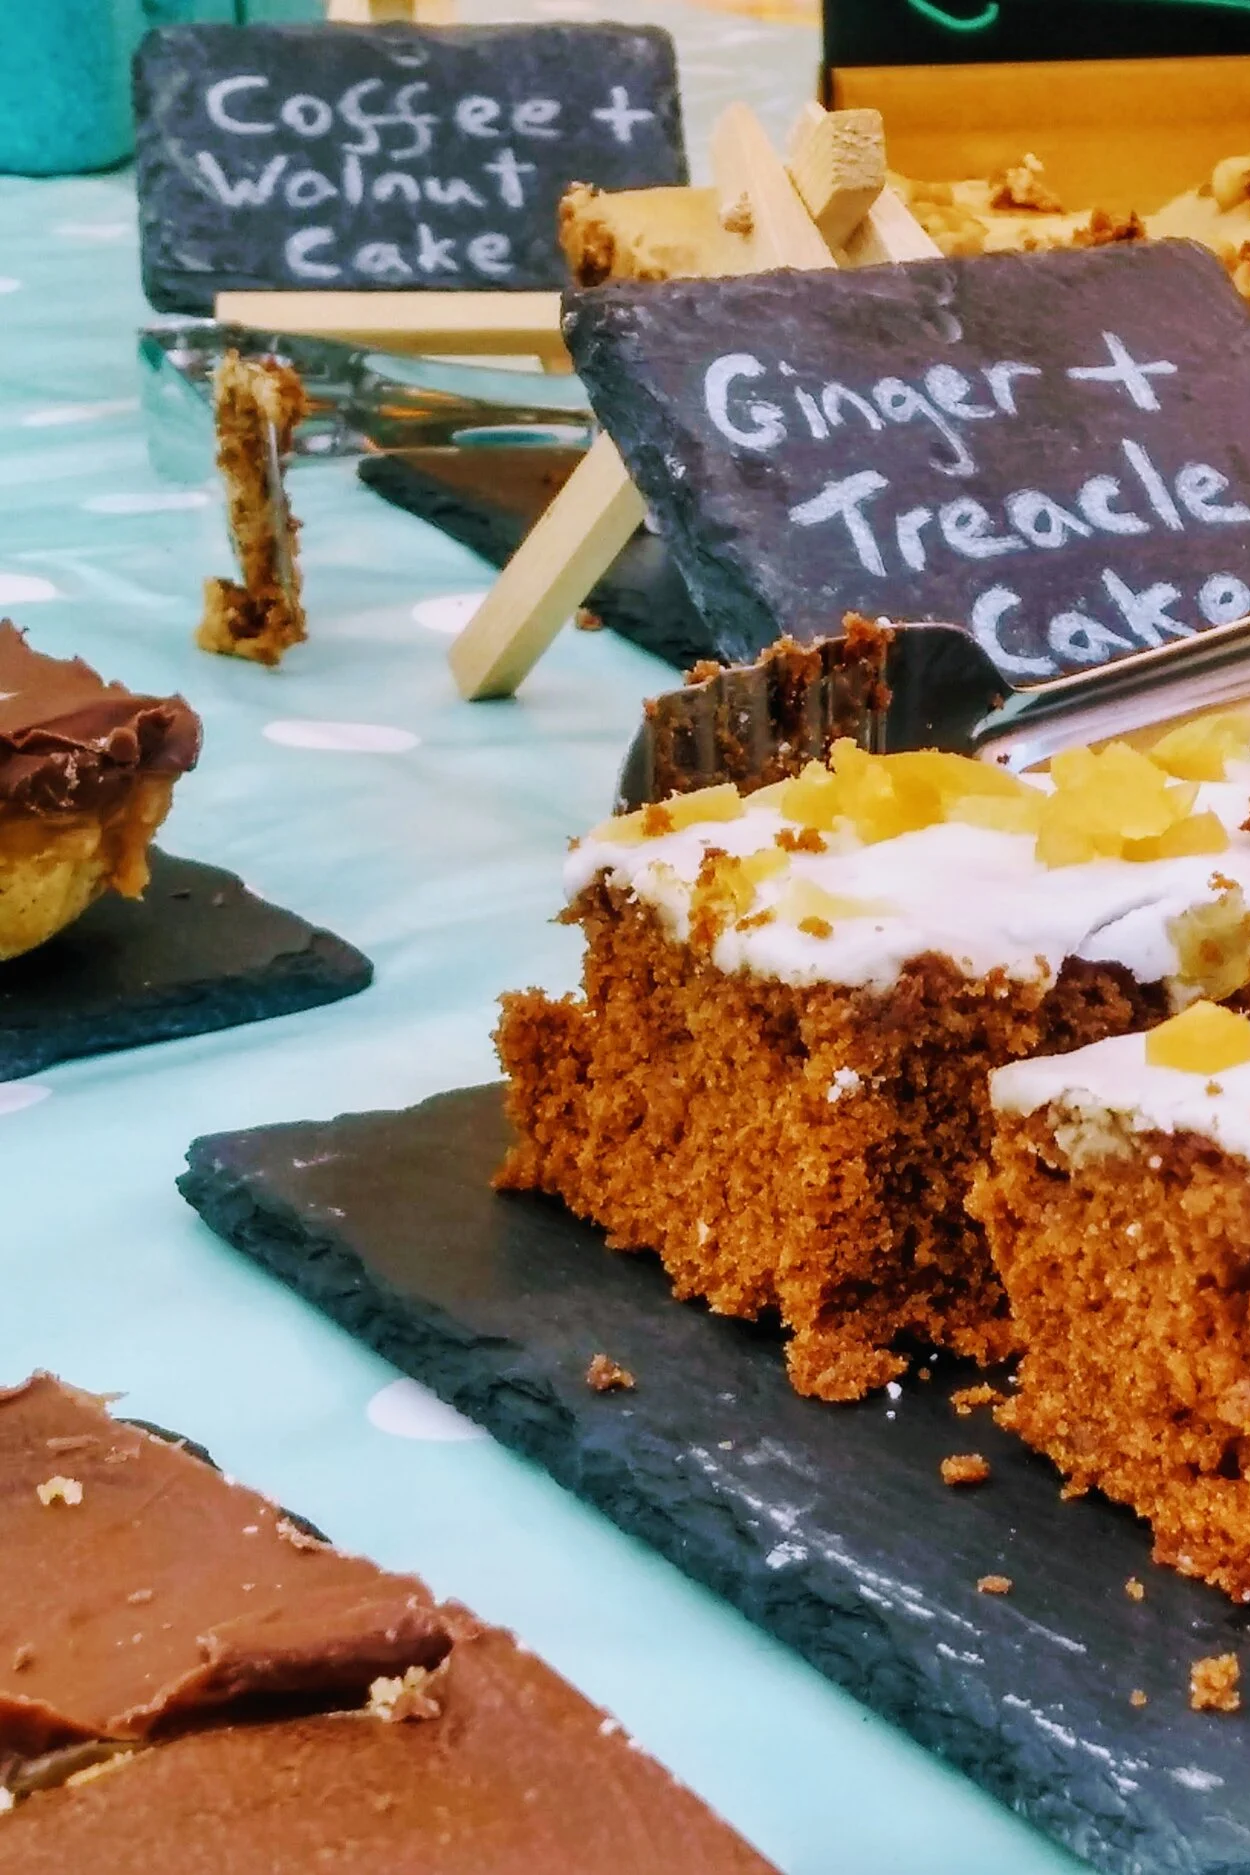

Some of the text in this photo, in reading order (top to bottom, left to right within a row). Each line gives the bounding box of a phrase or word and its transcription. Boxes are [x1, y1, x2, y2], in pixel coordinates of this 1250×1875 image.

[204, 75, 562, 160] Coffee
[198, 147, 537, 208] Walnut
[704, 330, 1178, 477] Ginger +
